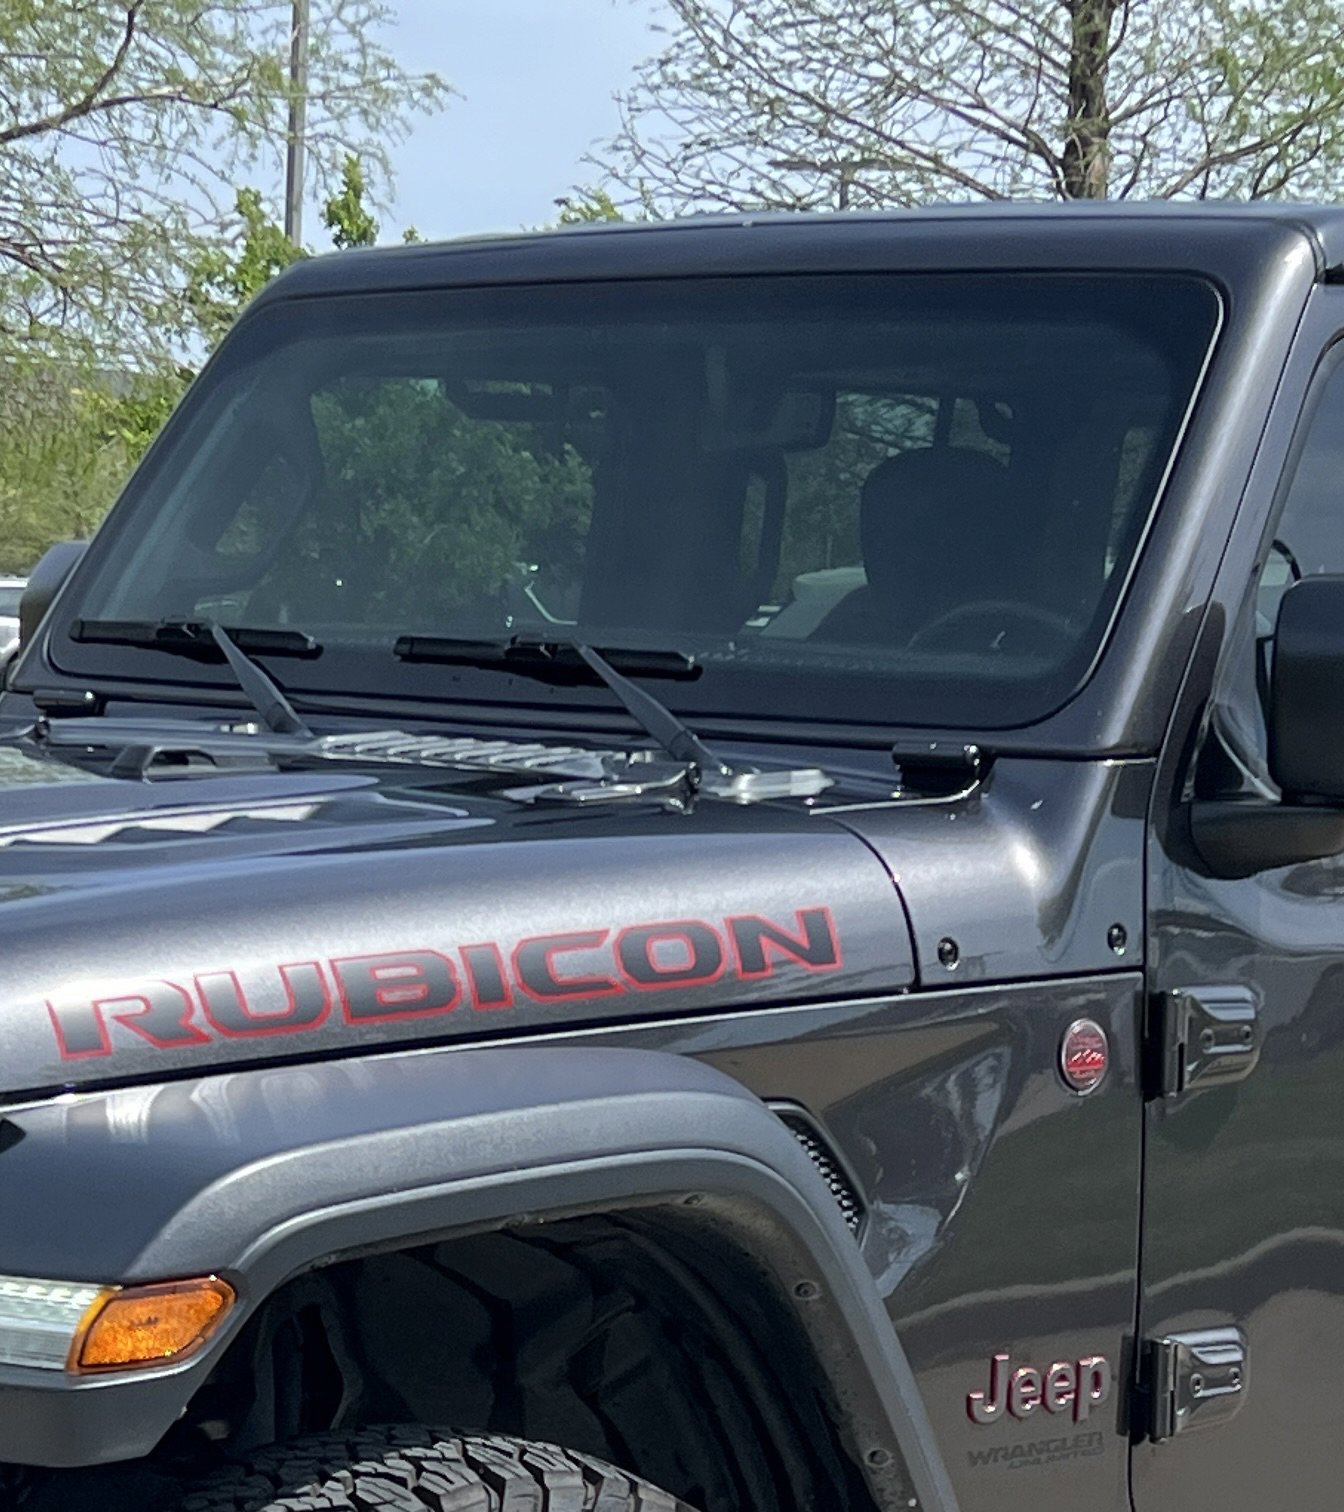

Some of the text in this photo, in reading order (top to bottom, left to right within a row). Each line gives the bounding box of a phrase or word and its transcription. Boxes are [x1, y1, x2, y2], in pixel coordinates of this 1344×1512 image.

[47, 906, 840, 1060] RUBICON
[966, 1352, 1112, 1425] Jeep
[967, 1431, 1104, 1468] WRANGLER
